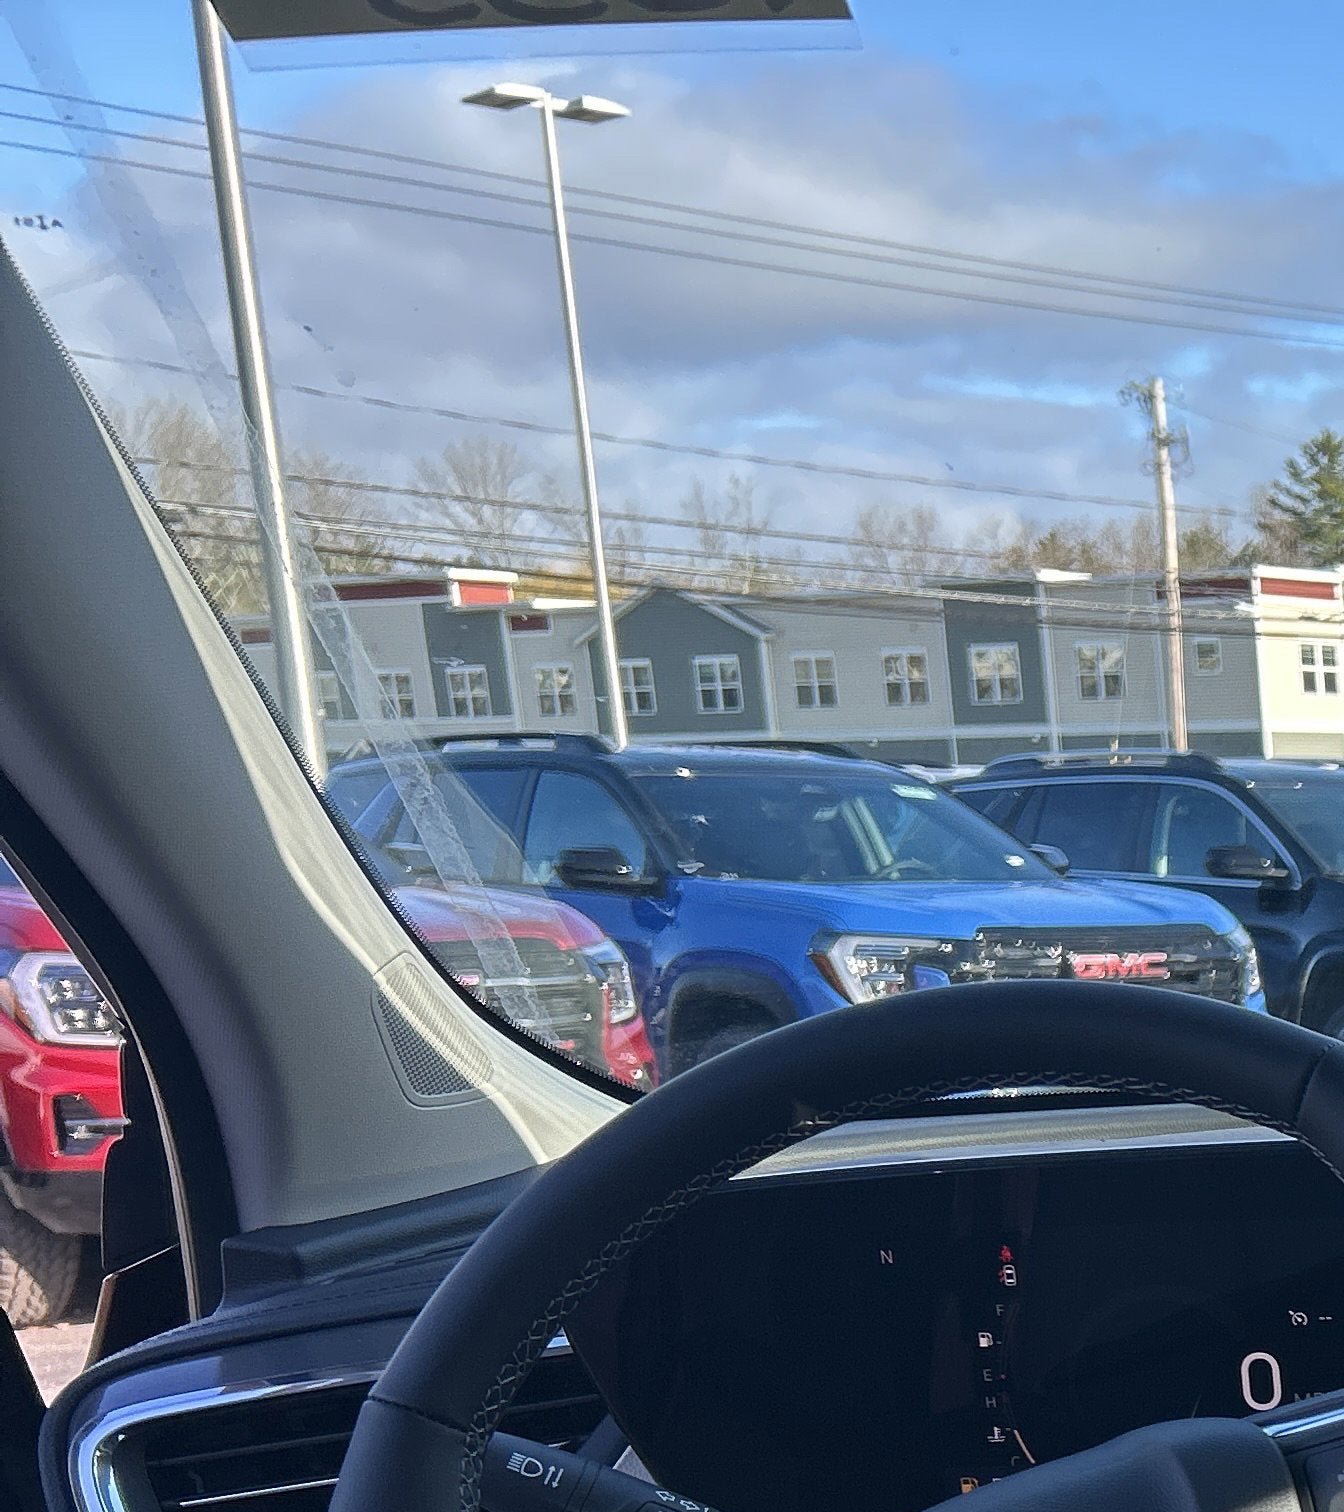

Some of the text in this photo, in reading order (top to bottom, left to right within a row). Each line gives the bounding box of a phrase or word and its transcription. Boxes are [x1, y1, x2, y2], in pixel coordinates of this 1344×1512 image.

[1073, 952, 1170, 980] GMC
[880, 1249, 894, 1265] N
[983, 1368, 993, 1382] E
[1240, 1351, 1282, 1411] 0
